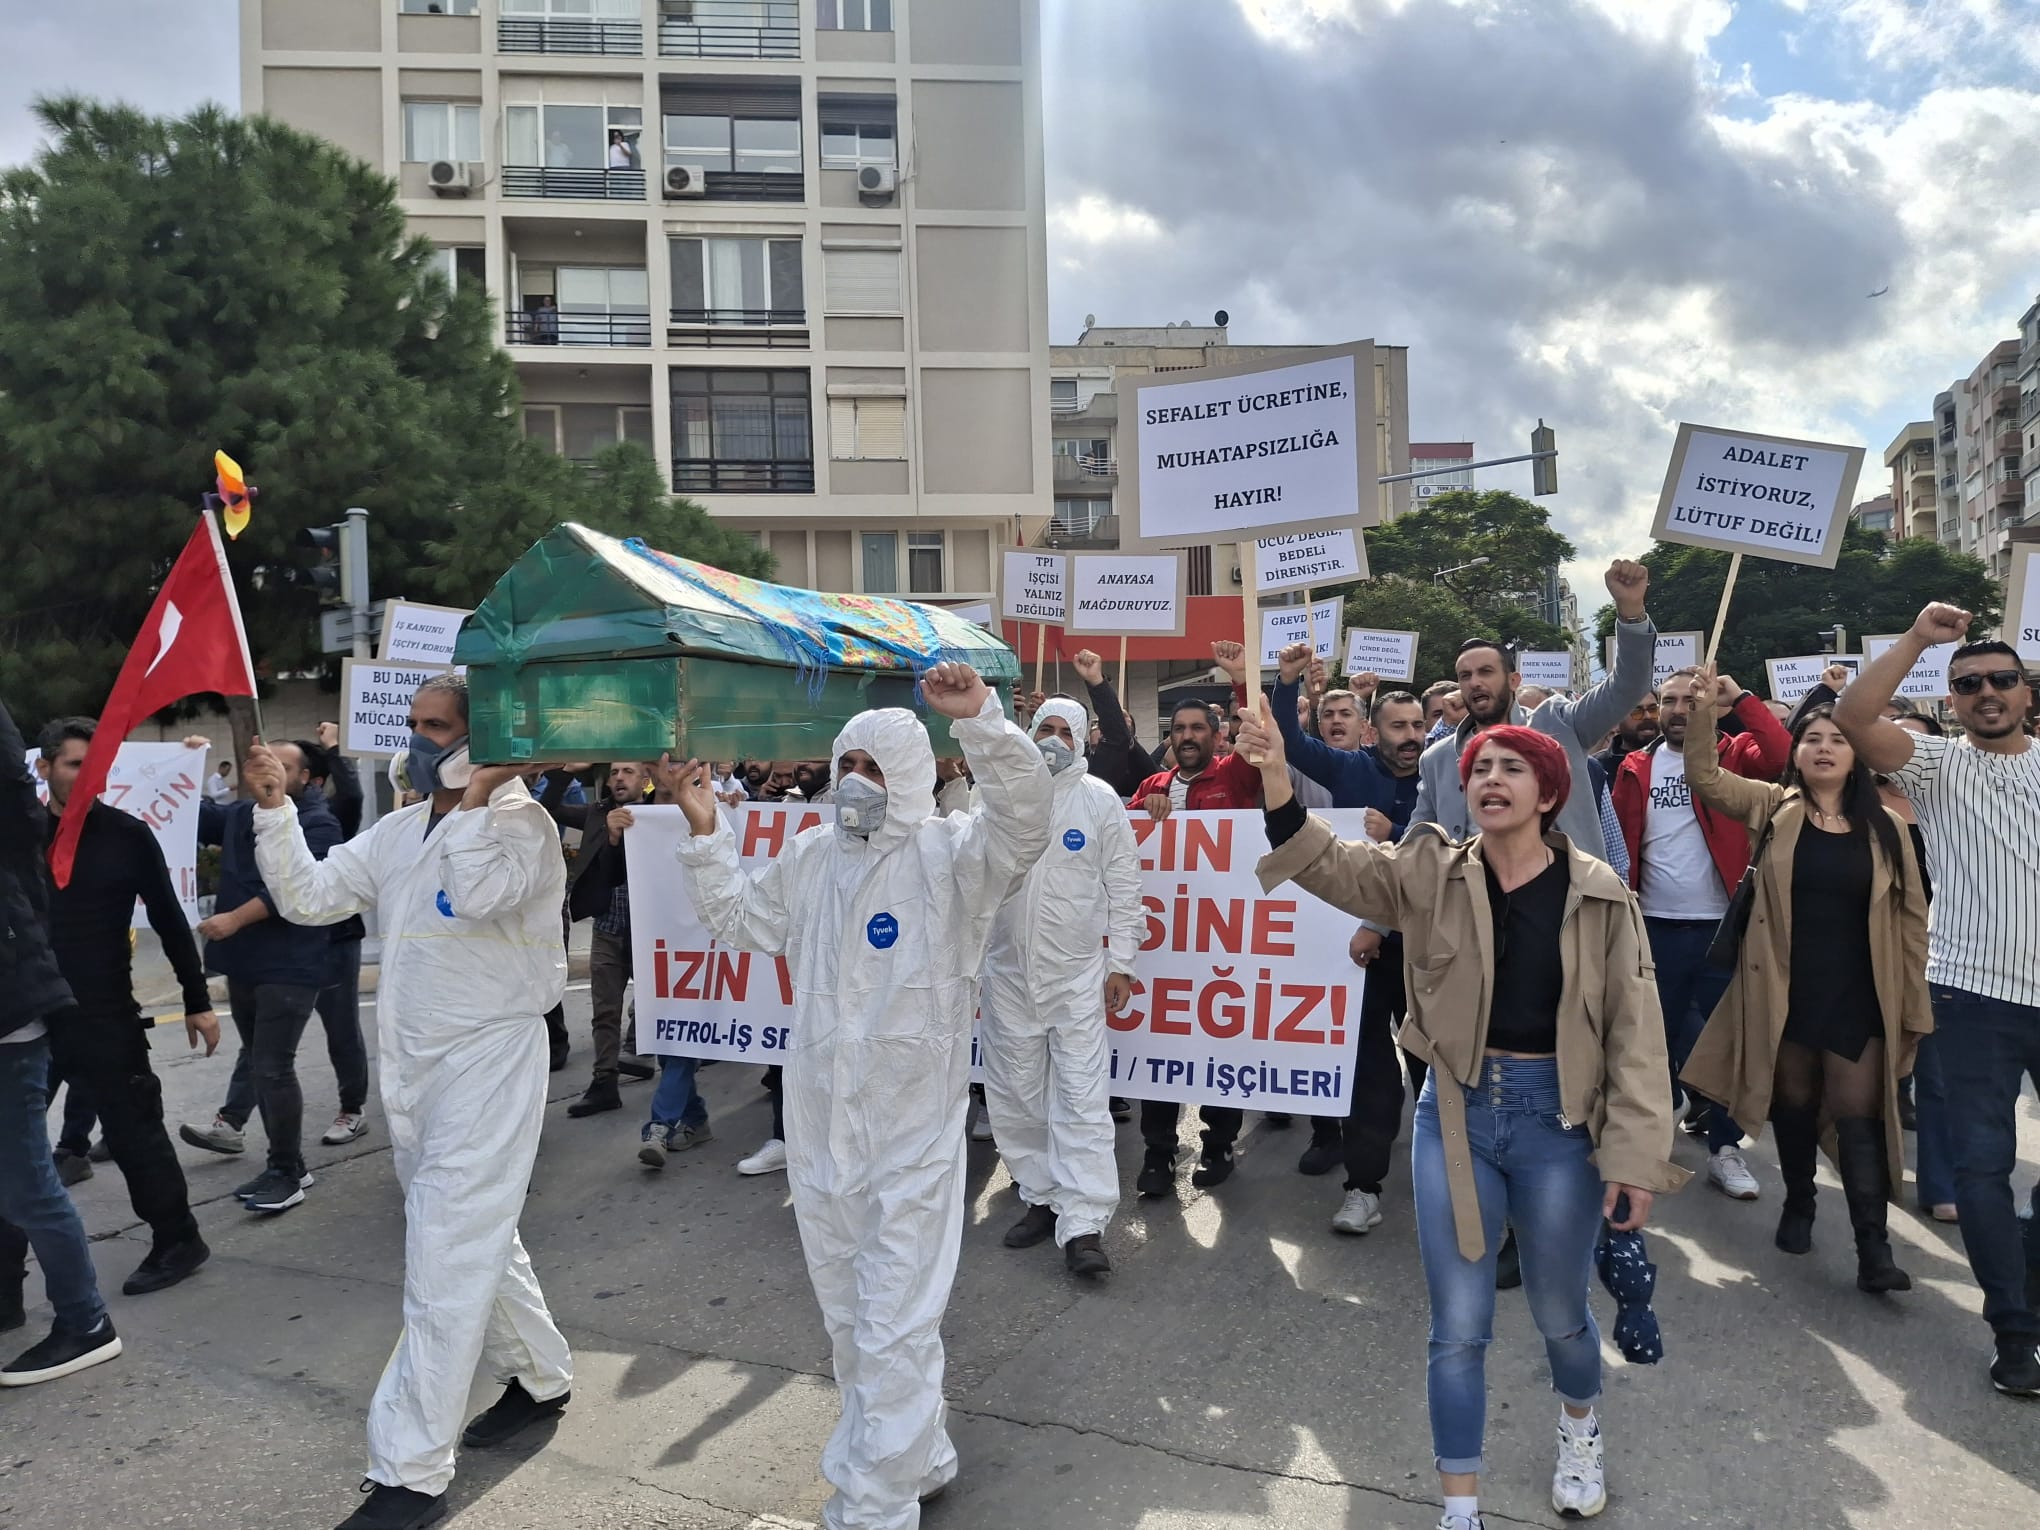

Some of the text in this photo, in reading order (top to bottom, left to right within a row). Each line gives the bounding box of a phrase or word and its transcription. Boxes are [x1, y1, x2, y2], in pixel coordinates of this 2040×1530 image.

[1146, 381, 1348, 425] SEFALET ÜCRETİNE,
[1157, 429, 1340, 470] MUHATAPSIZLIĞA
[1722, 446, 1809, 471] ADALET
[1214, 486, 1283, 510] HAYIR!
[1696, 473, 1816, 511] İSTİYORUZ,
[1674, 505, 1823, 544] LÜTUF DEĞİL!
[1257, 535, 1295, 549] UCUZ
[1036, 556, 1054, 568] TPI
[1028, 571, 1059, 586] İŞÇİSİ
[1097, 574, 1154, 585] ANAYASA
[1024, 588, 1062, 601] YALNIZ
[1078, 598, 1172, 612] MAĞDURUYUZ.
[1271, 609, 1331, 626] GREVDYİZ
[406, 622, 446, 635] KANUNU
[1776, 663, 1798, 672] HAK
[373, 671, 428, 686] BU DAHA
[1779, 674, 1823, 685] VERİLME
[1902, 684, 1934, 693] GELİR!
[362, 691, 413, 708] BAŞLAN
[354, 710, 411, 727] MÜCAD
[374, 734, 409, 749] DEVA
[1650, 784, 1690, 799] ORTH
[1653, 795, 1691, 810] FACE
[873, 925, 893, 936] Tyvek
[654, 939, 751, 1002] İZİN
[1106, 965, 1347, 1045] CEĞİZ!
[656, 1018, 752, 1052] PETROL-İŞ
[1146, 1058, 1194, 1086] TPI
[1206, 1056, 1341, 1098] İŞÇİLERİ
